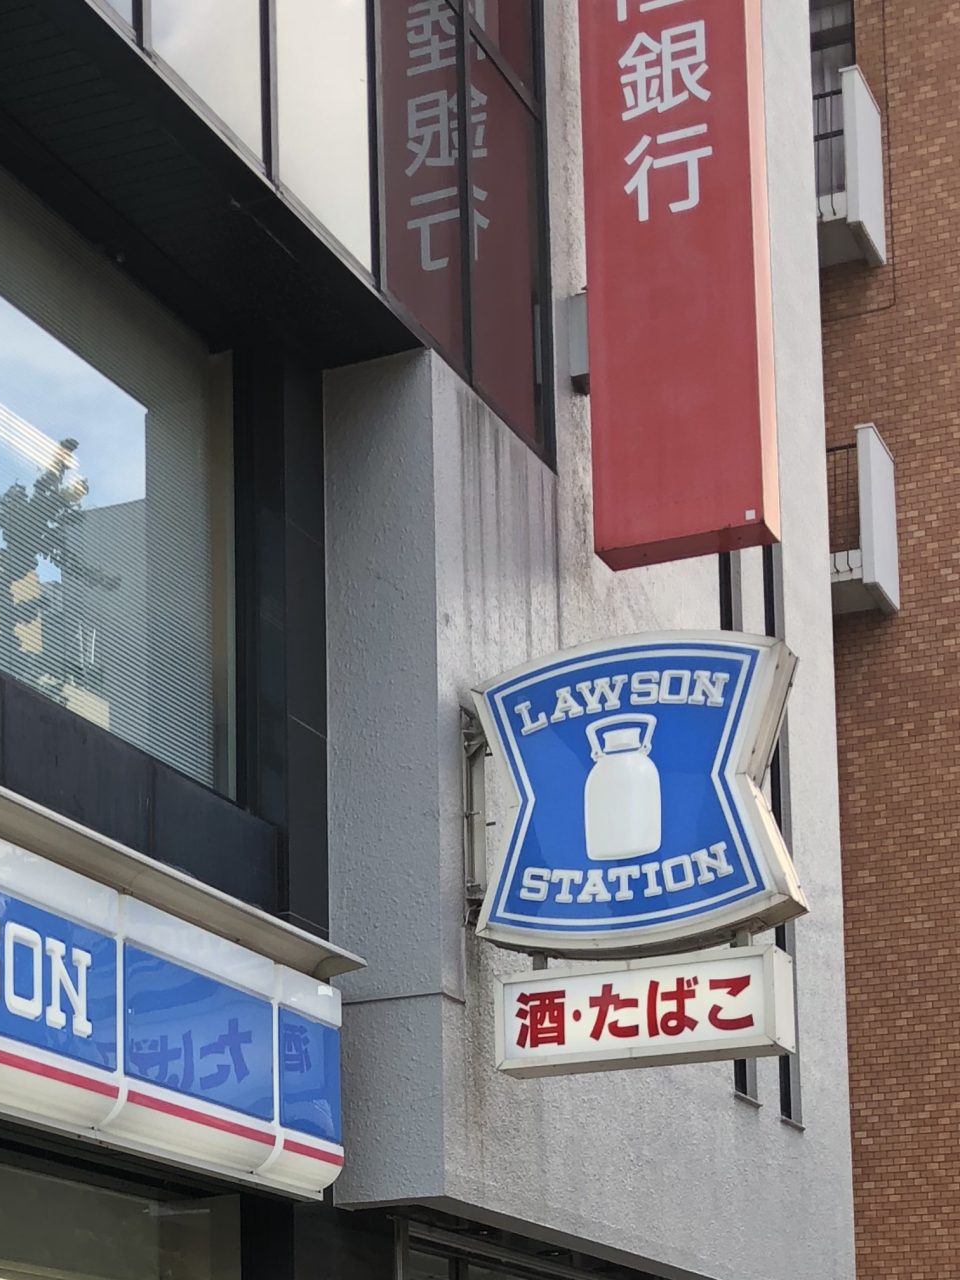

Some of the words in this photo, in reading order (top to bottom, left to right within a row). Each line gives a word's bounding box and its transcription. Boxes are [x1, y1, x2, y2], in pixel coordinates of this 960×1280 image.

[617, 0, 713, 222] 銀行
[514, 669, 730, 737] LAWSON
[519, 841, 734, 904] STATION
